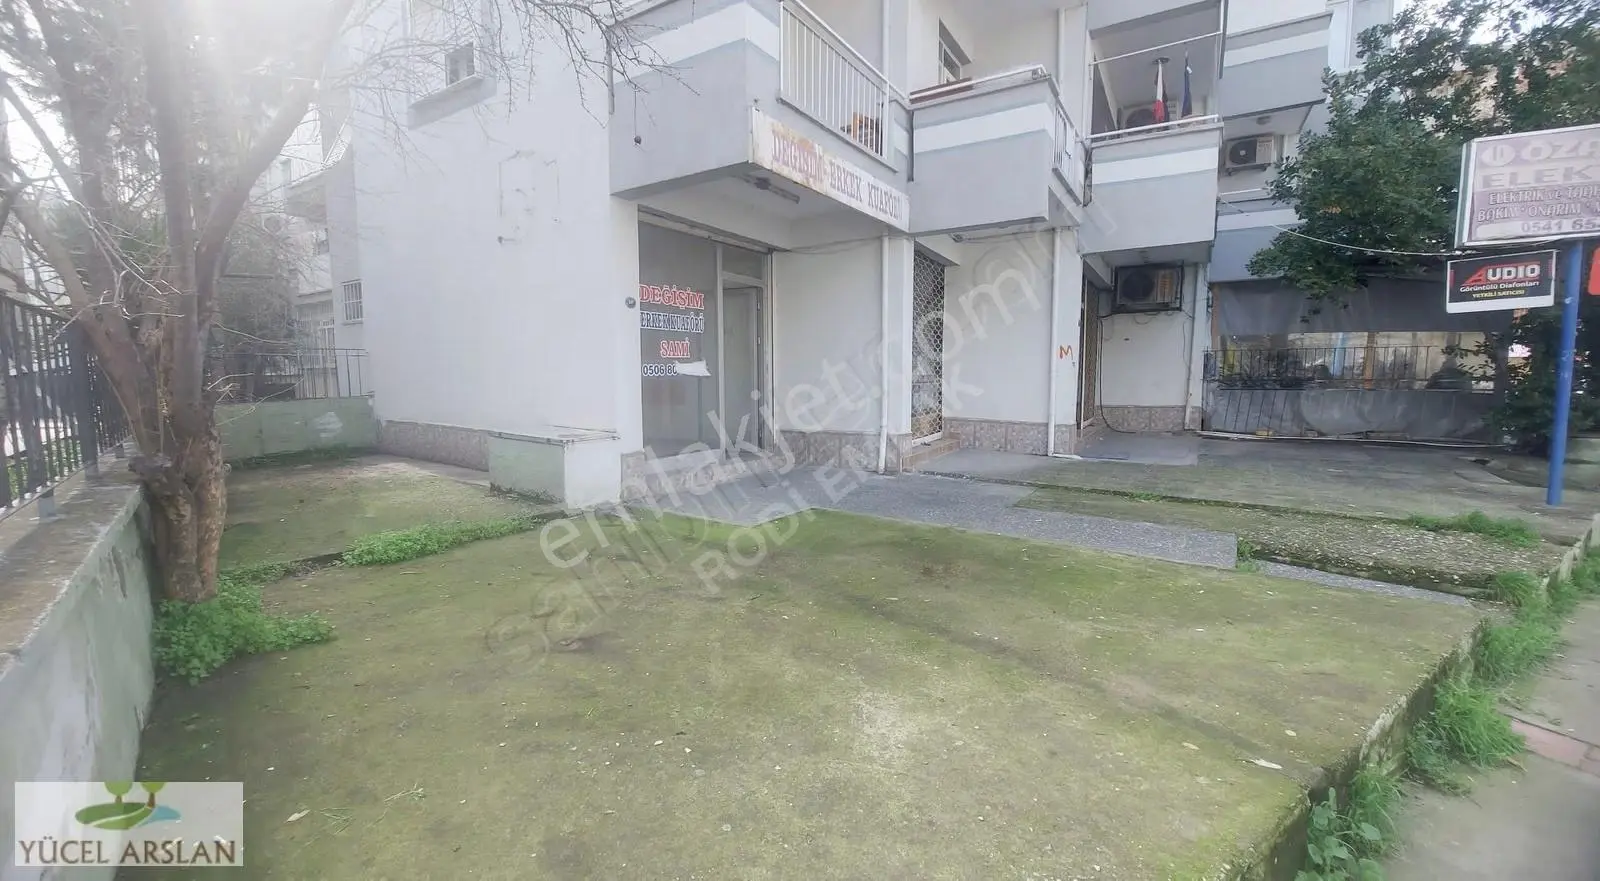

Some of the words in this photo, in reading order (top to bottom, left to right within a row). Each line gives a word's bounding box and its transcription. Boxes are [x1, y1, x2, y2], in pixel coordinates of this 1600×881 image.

[1521, 219, 1562, 233] 0541
[1462, 263, 1541, 287] AUDIO
[639, 284, 704, 310] DEĞİŞİM
[1459, 284, 1498, 293] Görüntülü
[1499, 280, 1540, 290] Diafonları
[640, 311, 669, 329] ERKEK
[670, 312, 704, 333] KUAFÖRÜ
[660, 337, 690, 358] SAMİ
[642, 363, 665, 377] 0506
